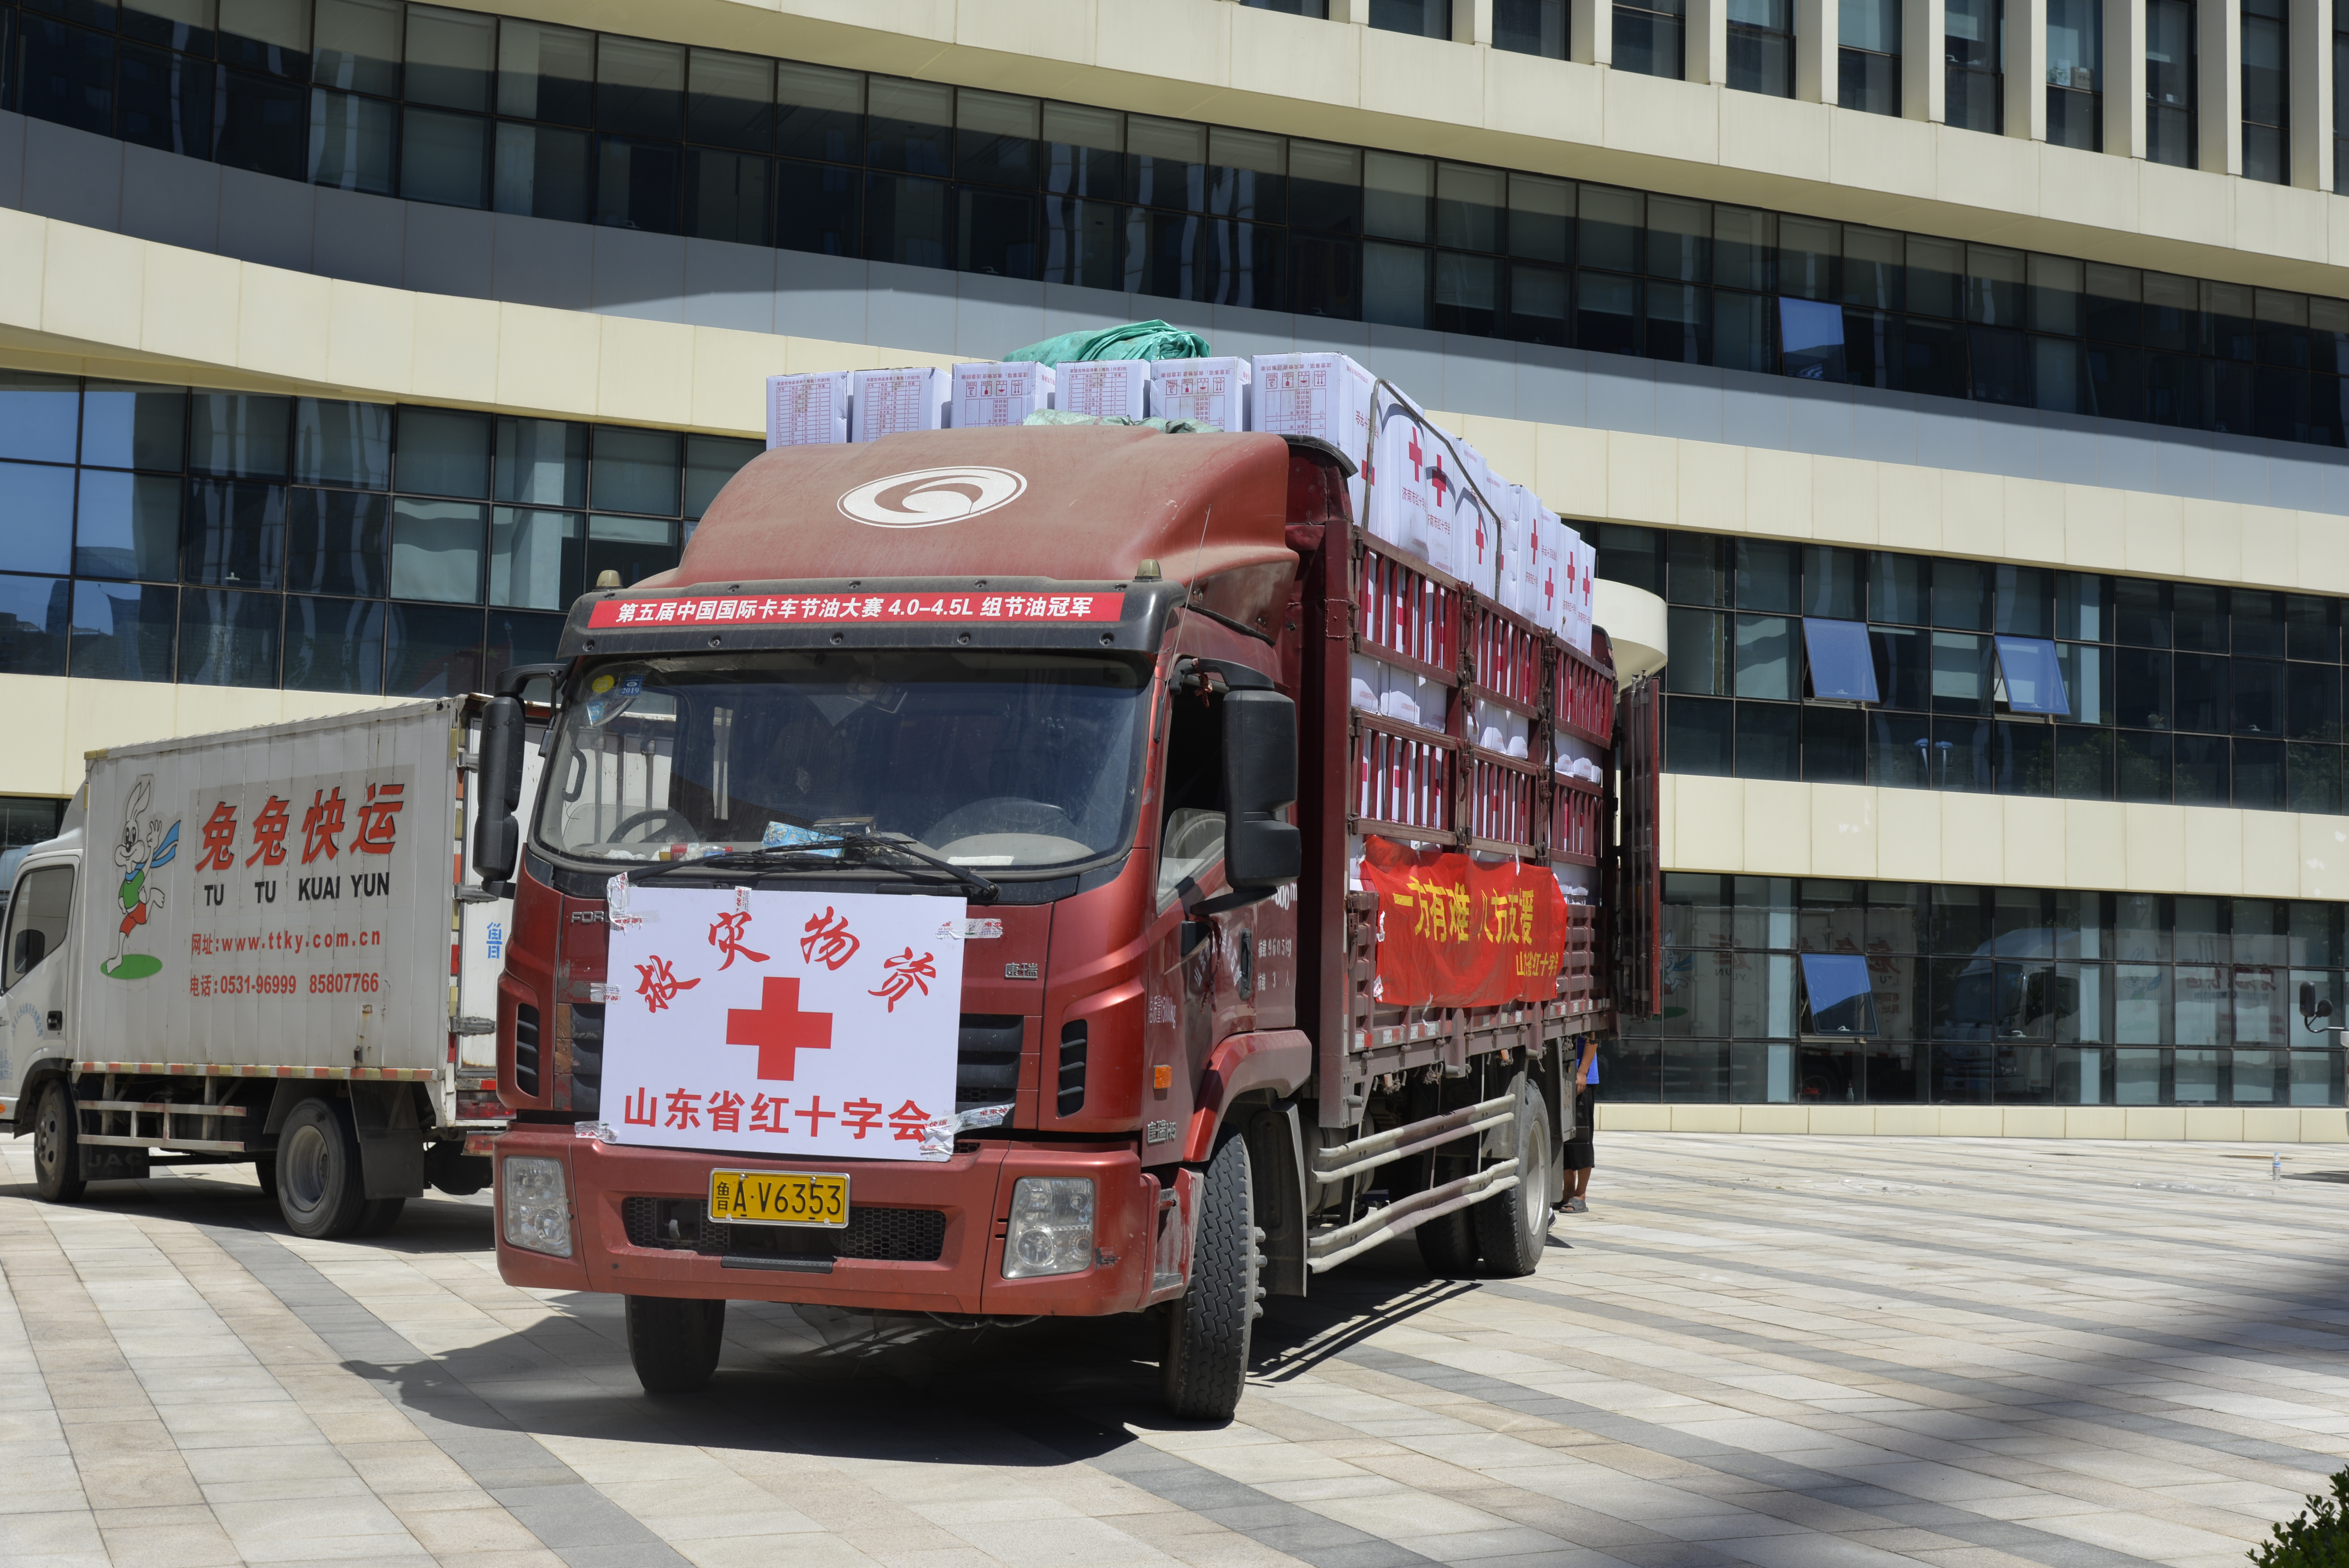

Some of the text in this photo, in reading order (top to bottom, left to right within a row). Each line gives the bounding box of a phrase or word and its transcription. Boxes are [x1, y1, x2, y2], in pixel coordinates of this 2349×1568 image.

[616, 599, 884, 622] 第五届中国国际卡车节油大赛
[979, 595, 1094, 618] 组节油冠军
[196, 782, 405, 872] 兔兔快运
[204, 872, 390, 907] TU TU KUAI YUN
[1393, 875, 1534, 946] 一方有难 八方支援
[309, 972, 379, 994] 85807766
[1272, 971, 1276, 988] 3
[1285, 969, 1290, 987] 人
[624, 1087, 932, 1143] 山东省红十字会
[87, 1153, 144, 1168] JAC
